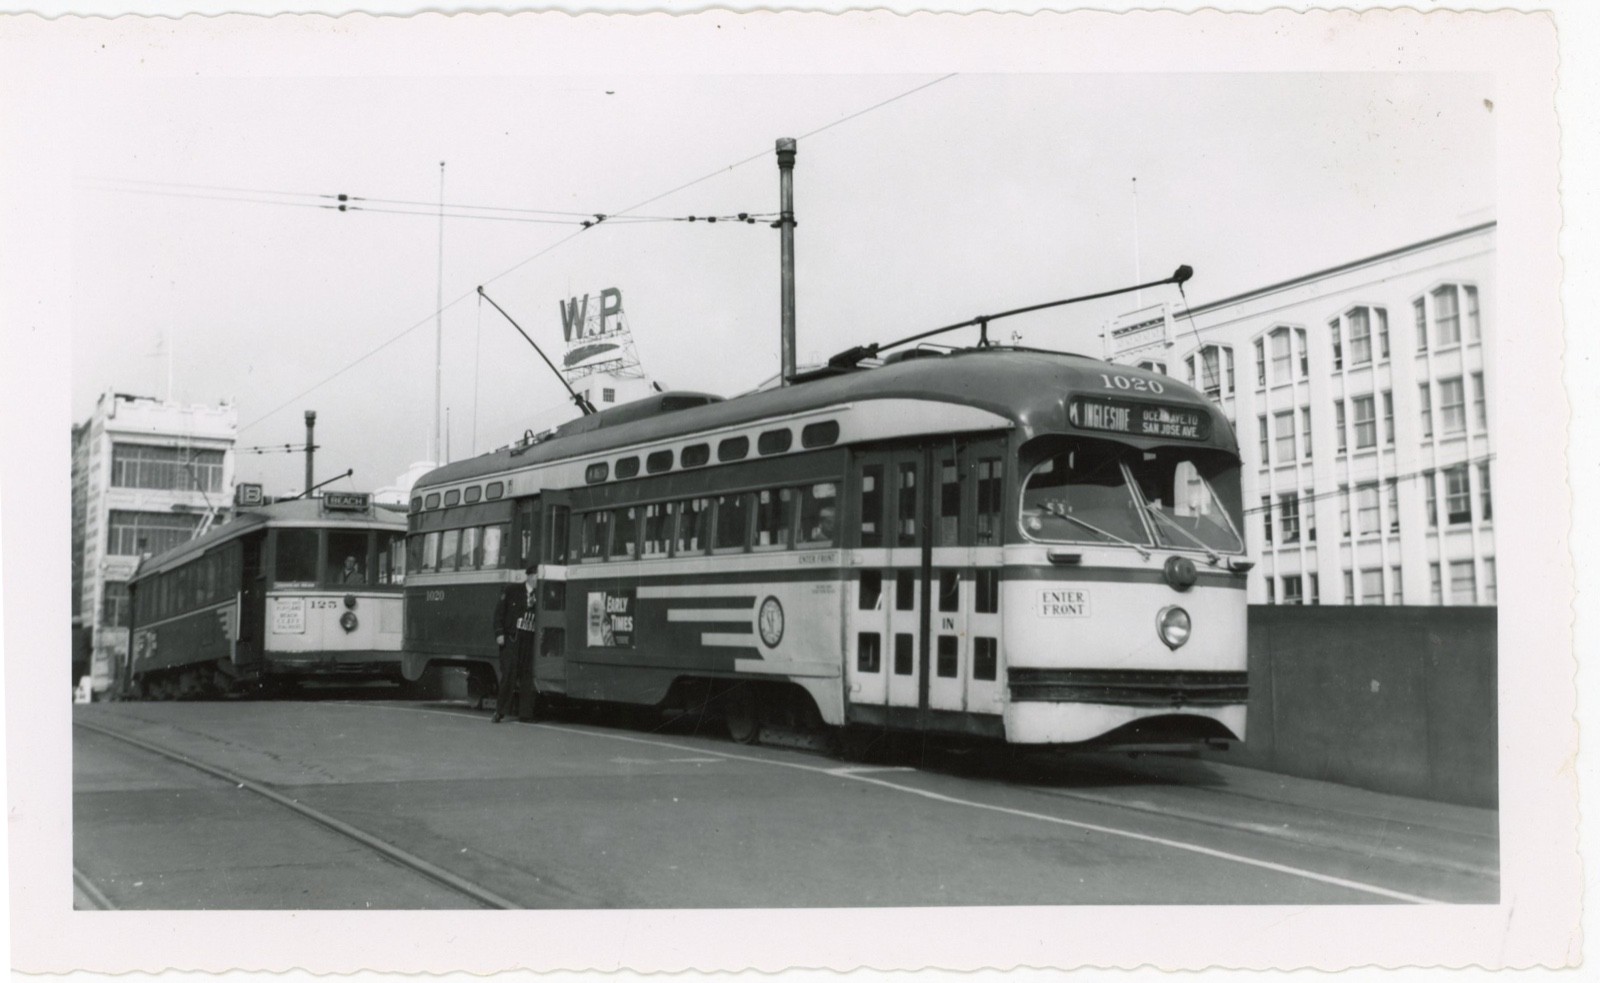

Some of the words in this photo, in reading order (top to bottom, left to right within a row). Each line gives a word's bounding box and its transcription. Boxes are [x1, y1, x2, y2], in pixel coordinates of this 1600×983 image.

[1101, 374, 1164, 394] 1020
[1084, 403, 1131, 431] INGLESIDE
[1143, 410, 1170, 422] OCE
[1142, 422, 1160, 434] SAN
[1161, 424, 1181, 436] JOSE
[245, 486, 261, 502] B
[330, 497, 363, 505] BEACH
[426, 590, 445, 601] 1020
[1042, 592, 1085, 603] ENTER
[310, 600, 337, 609] 125
[606, 596, 629, 613] EARLY
[1042, 604, 1084, 615] FRONT
[610, 614, 634, 632] TIMES
[942, 617, 954, 630] IN
